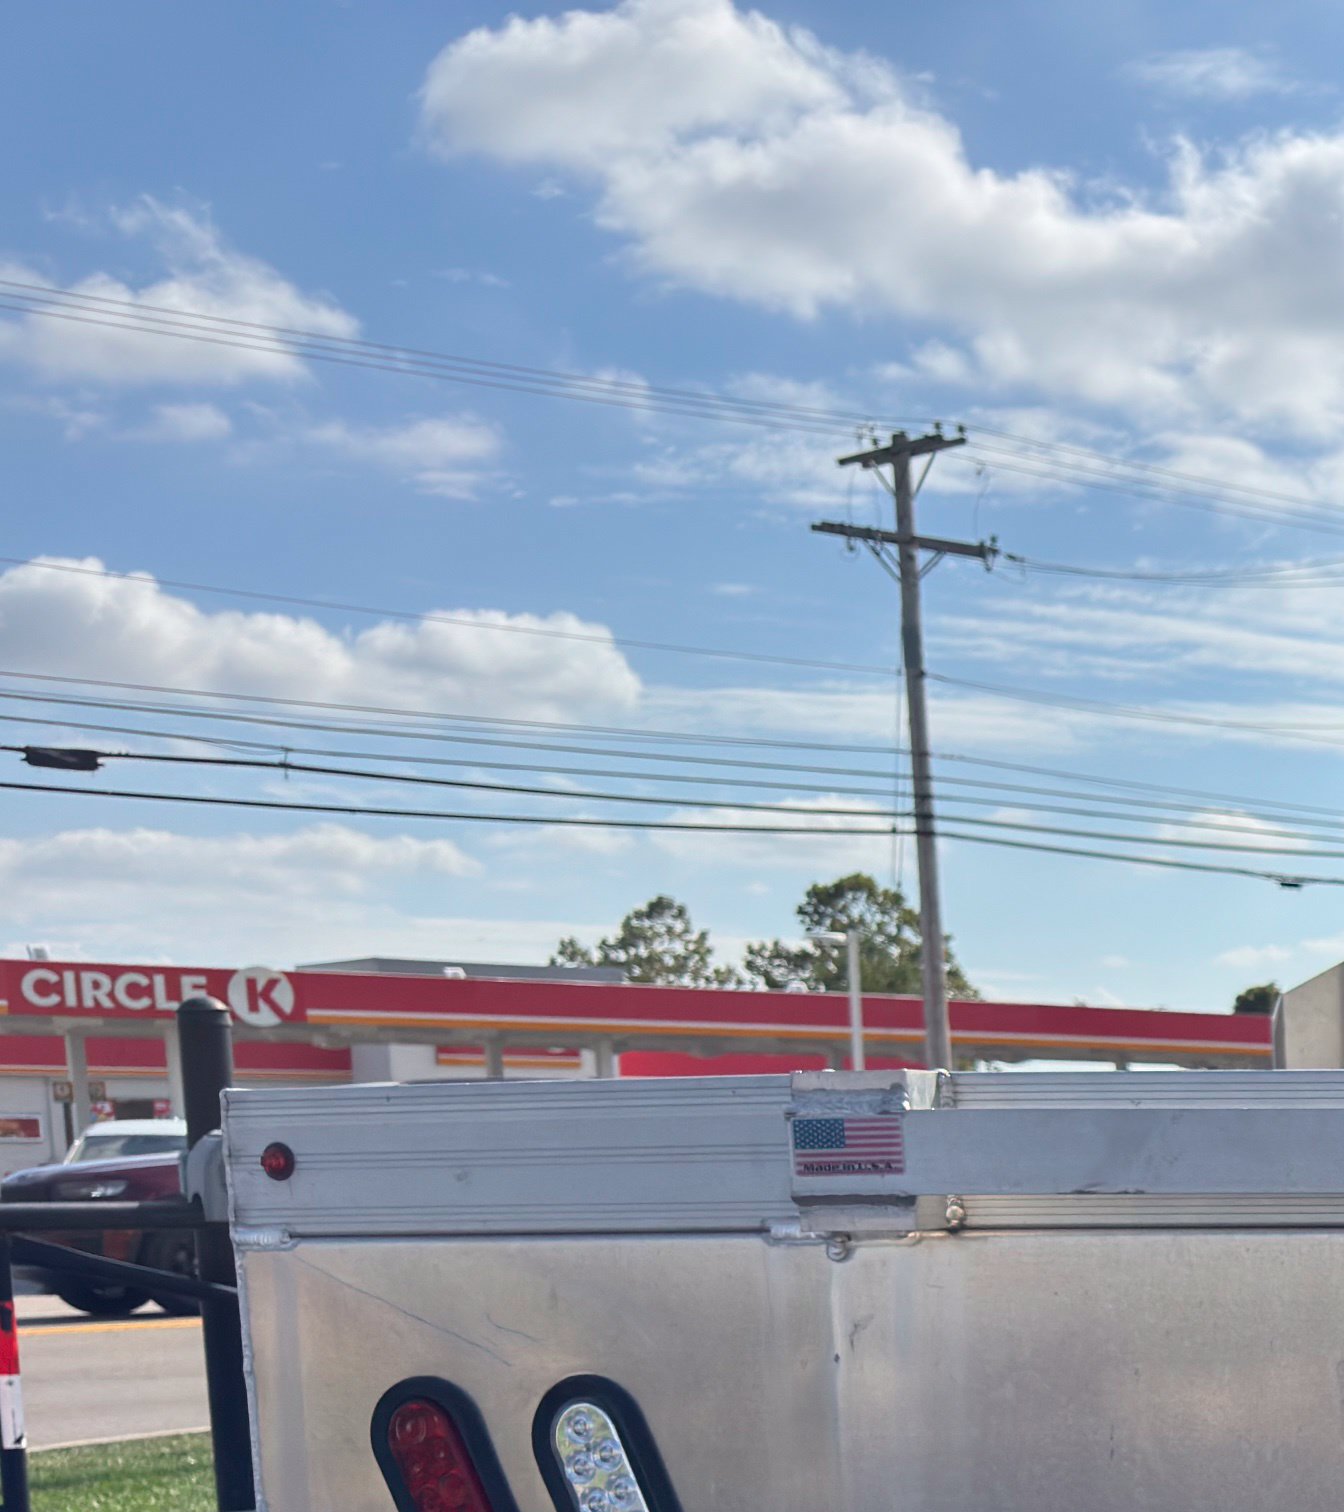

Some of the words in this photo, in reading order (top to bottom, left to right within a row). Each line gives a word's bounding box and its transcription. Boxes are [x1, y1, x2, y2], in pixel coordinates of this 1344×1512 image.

[21, 967, 209, 1011] CIRCLE
[245, 975, 292, 1017] K
[803, 1162, 840, 1174] Made
